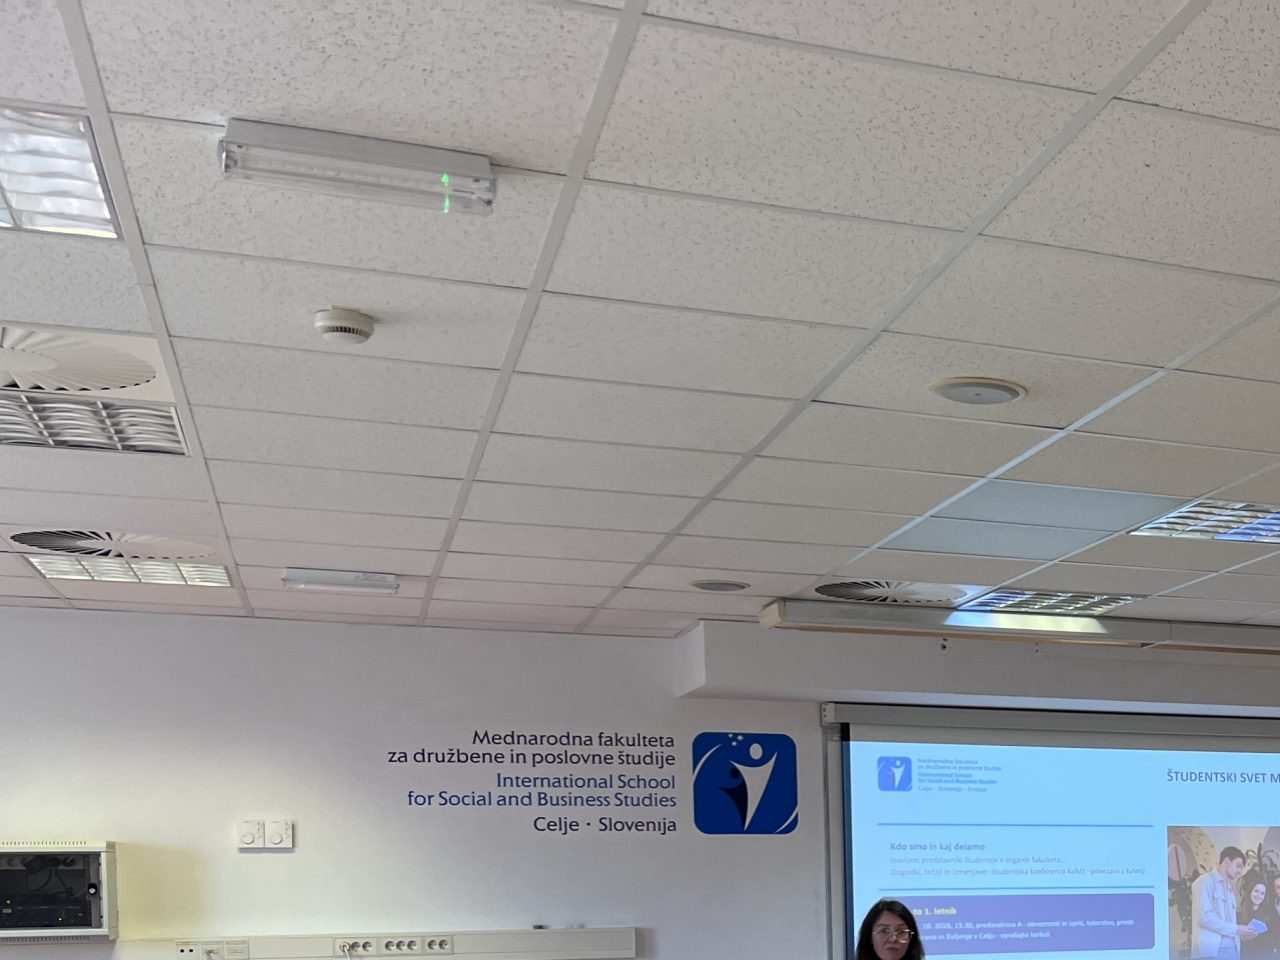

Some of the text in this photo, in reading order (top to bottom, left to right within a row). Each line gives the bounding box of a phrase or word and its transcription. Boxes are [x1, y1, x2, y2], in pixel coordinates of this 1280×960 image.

[472, 730, 675, 749] Mednarodna fakulteta
[388, 748, 675, 768] za družbene in poslovne študije
[497, 773, 675, 789] International School
[1167, 769, 1237, 783] ŠTUDENTSKI
[1240, 772, 1267, 783] SVET
[408, 790, 676, 808] for Social and Business Studies
[534, 816, 676, 836] Celje Slovenija
[890, 842, 907, 851] Kdo
[930, 843, 938, 851] in
[939, 842, 952, 853] kaj
[954, 842, 986, 851] delamo
[934, 907, 958, 915] letnik
